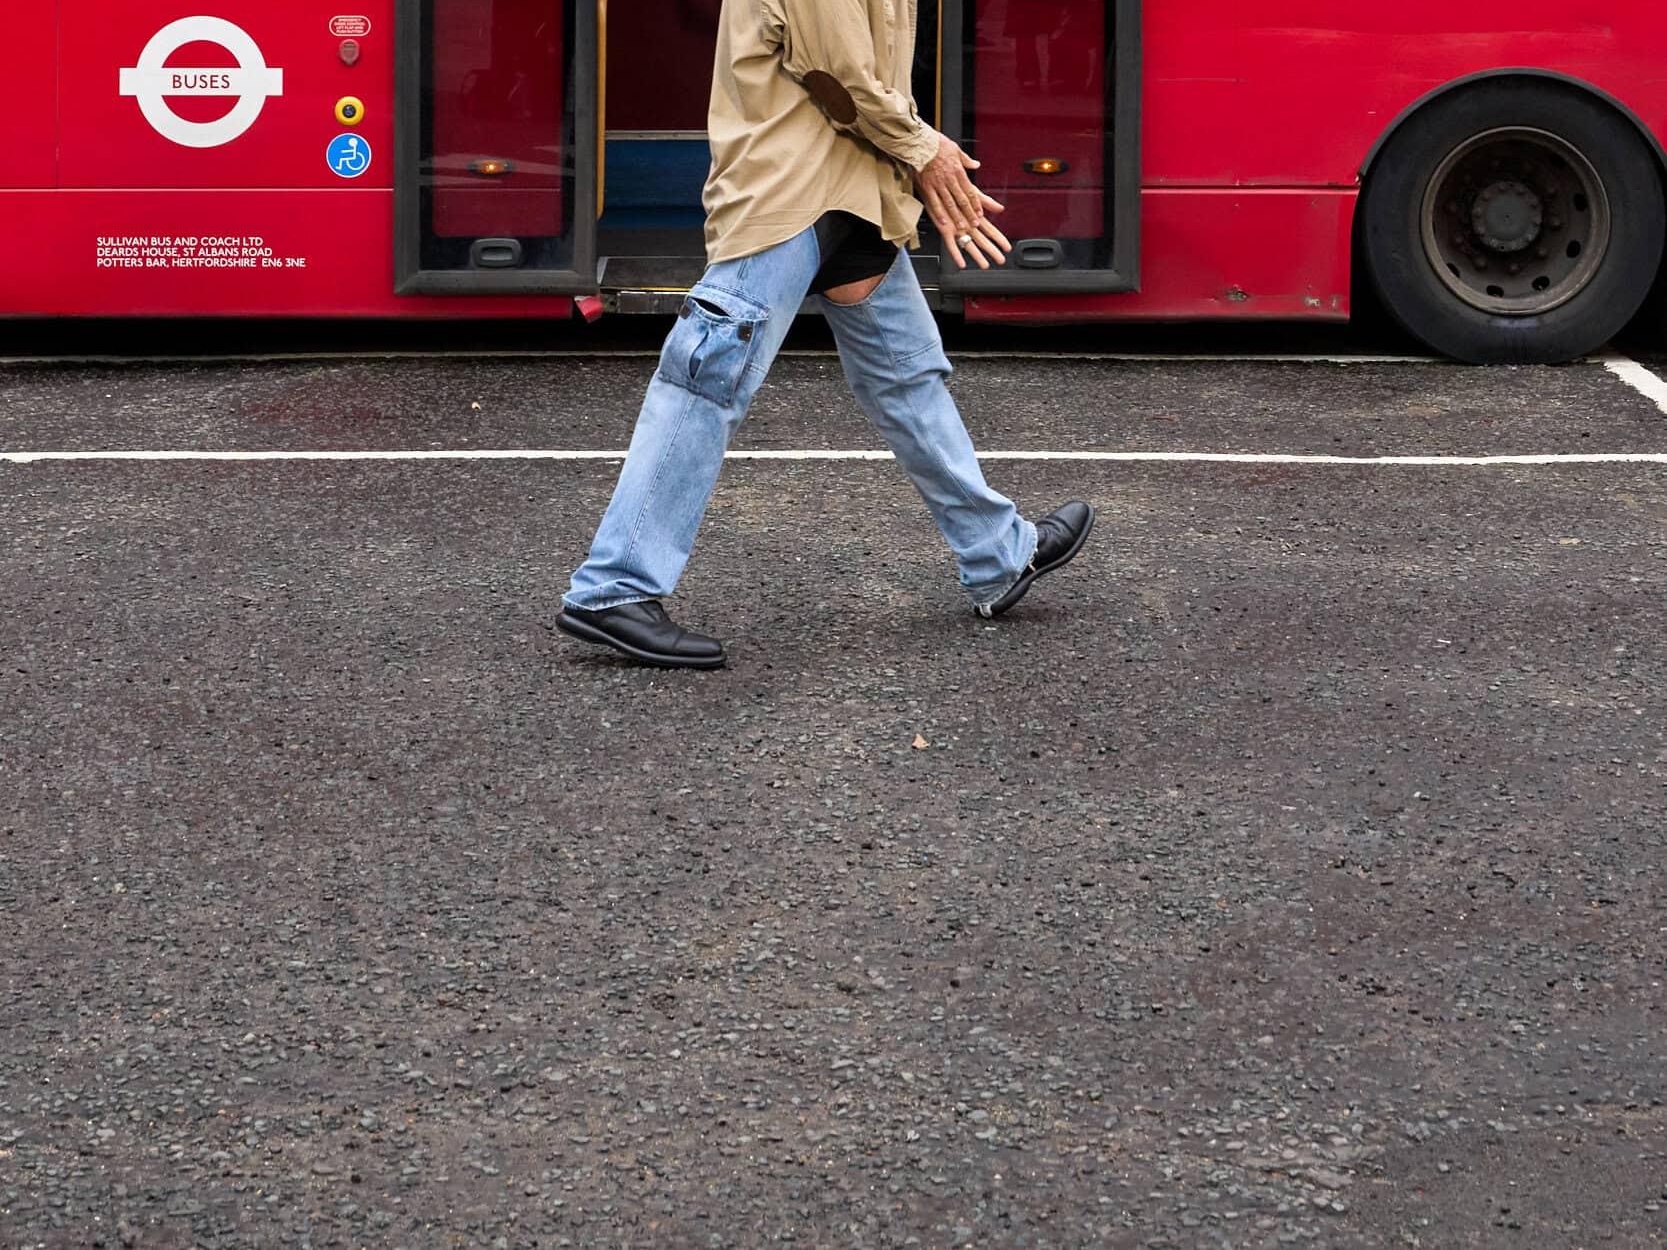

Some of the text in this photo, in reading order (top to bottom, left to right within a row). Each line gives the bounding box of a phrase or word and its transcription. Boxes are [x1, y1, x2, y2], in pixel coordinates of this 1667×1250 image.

[172, 74, 230, 89] BUSES
[97, 237, 263, 247] SULLIVAN BUS AND COACH LTD
[97, 247, 139, 257] DEARDS
[183, 247, 195, 257] ST
[198, 247, 239, 257] ALBANS
[242, 247, 272, 257] ROAD
[97, 258, 306, 269] POTTERS BAR, HERTFORDSHIRE EN6 3NE
